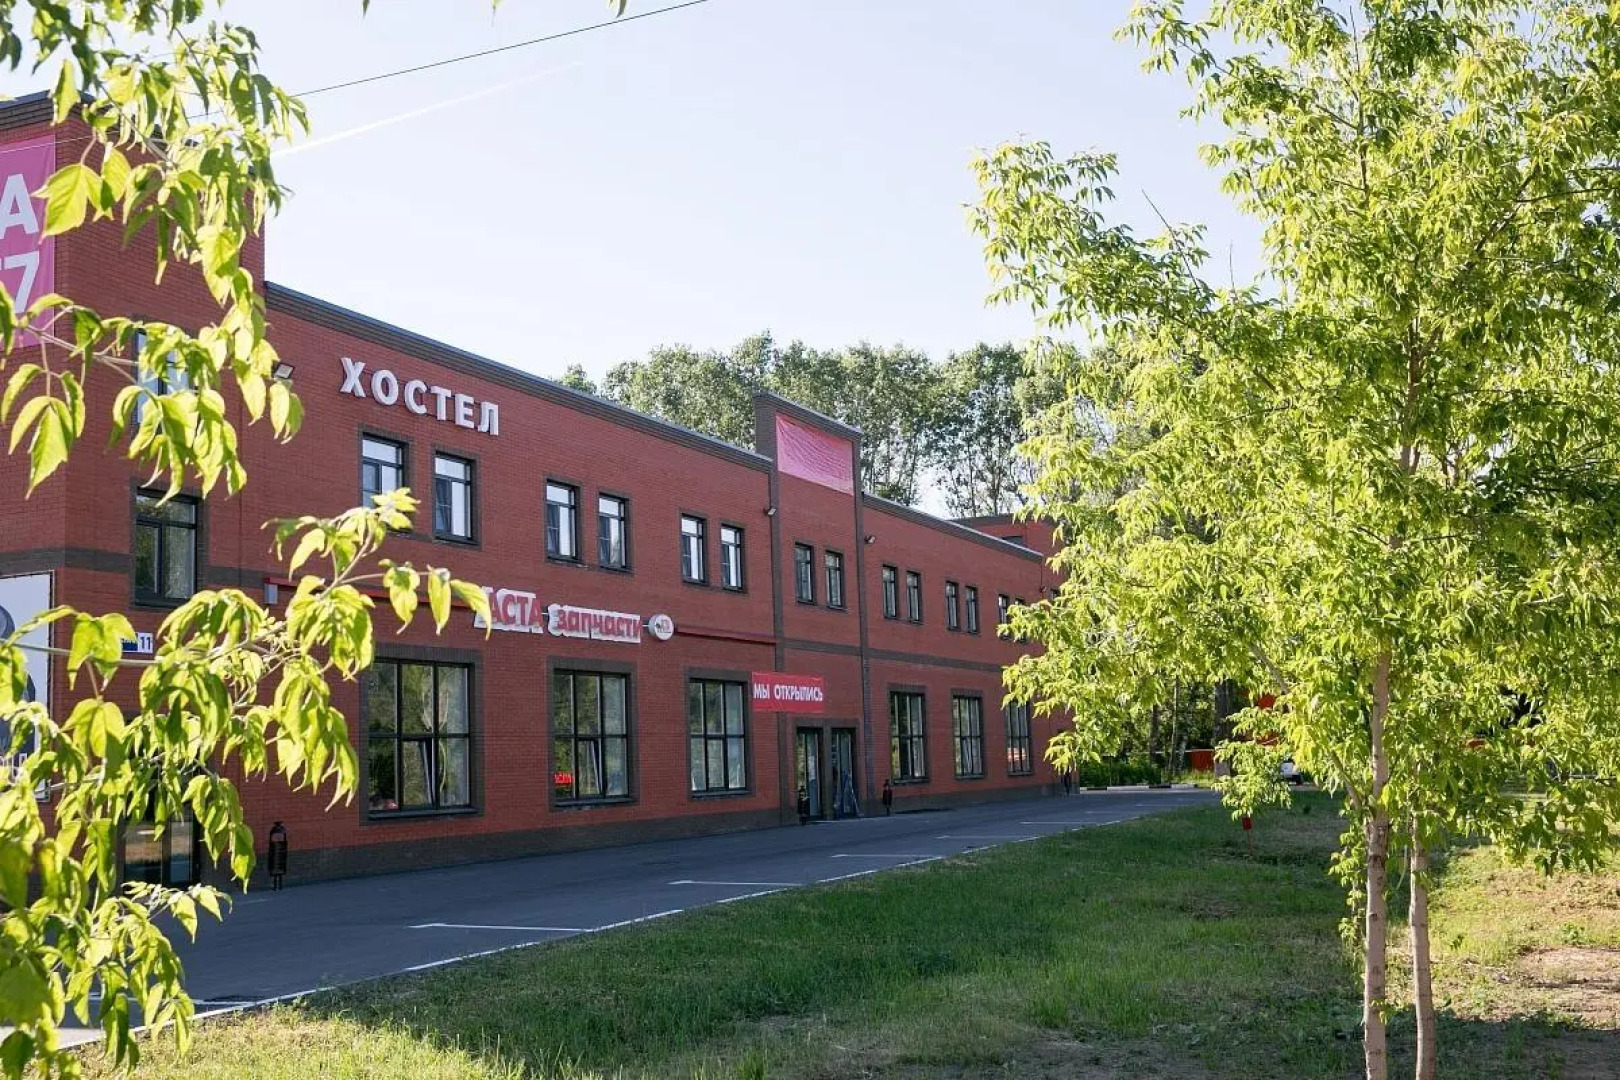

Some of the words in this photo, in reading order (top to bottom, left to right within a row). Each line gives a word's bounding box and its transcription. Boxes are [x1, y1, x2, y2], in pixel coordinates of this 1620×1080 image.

[0, 251, 40, 313] 7
[340, 357, 499, 436] ХОСТЕЛ
[556, 607, 643, 639] запчасти
[140, 636, 151, 650] 11
[753, 683, 770, 699] МЫ
[774, 684, 823, 702] ОТКРЫЛИСЬ
